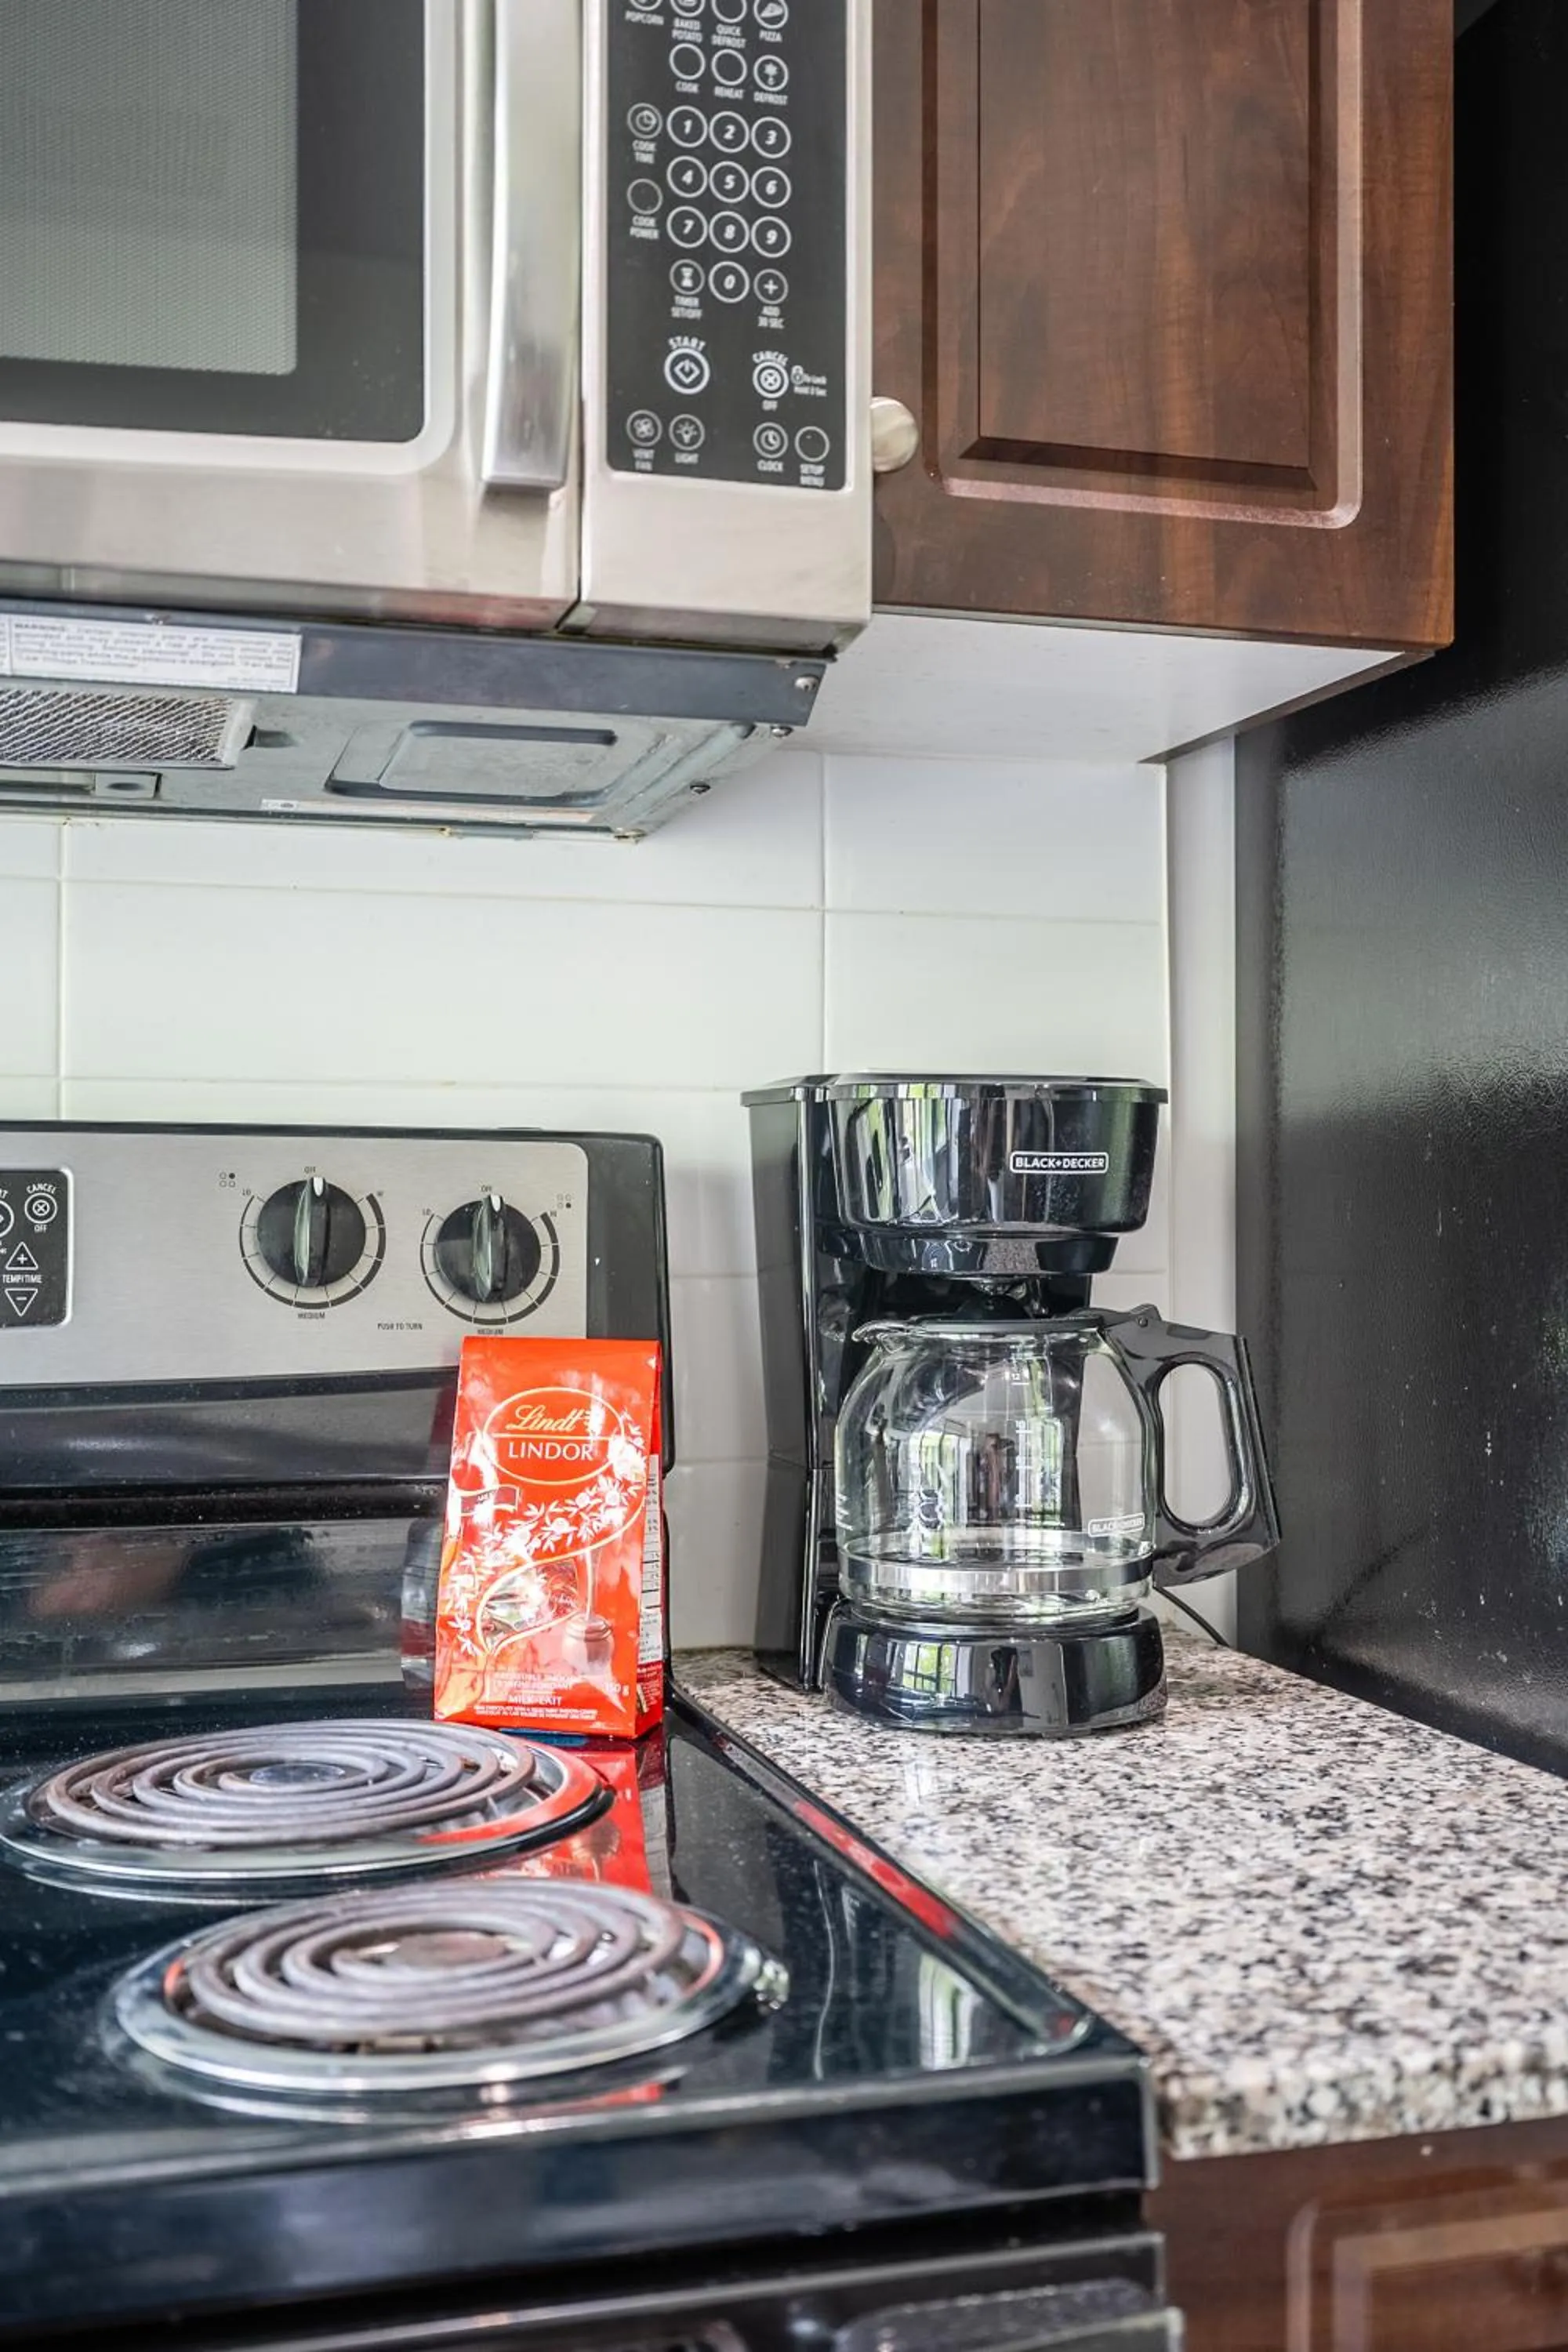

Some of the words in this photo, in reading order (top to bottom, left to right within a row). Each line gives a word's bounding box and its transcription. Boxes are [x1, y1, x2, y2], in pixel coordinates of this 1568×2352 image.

[625, 10, 664, 25] POPCORN
[673, 18, 700, 31] BAKED
[672, 30, 702, 42] POTATO
[717, 24, 741, 36] QUICK
[759, 30, 782, 42] PIZZA
[712, 34, 746, 48] DEFROST
[676, 81, 699, 93] COOK
[714, 86, 744, 100] REHEAT
[754, 92, 788, 105] DEFROST
[684, 119, 692, 135] 1
[723, 125, 735, 140] 2
[765, 130, 778, 145] 3
[632, 140, 657, 152] COOK
[634, 152, 655, 164] TIME
[681, 169, 694, 185] 4
[724, 174, 735, 190] 5
[765, 180, 778, 195] 6
[632, 215, 656, 227] COOK
[683, 220, 695, 234] 7
[724, 224, 736, 239] 8
[765, 229, 778, 245] 9
[724, 274, 736, 290] 0
[668, 336, 706, 350] START
[752, 350, 789, 366] CANCEL
[757, 459, 784, 473] CLOCK
[1015, 1156, 1105, 1169] BLACK+DECKER
[26, 1183, 57, 1194] CANCEL
[34, 1224, 48, 1234] OFF
[506, 1404, 585, 1432] Lindt
[509, 1442, 593, 1461] LINDOR
